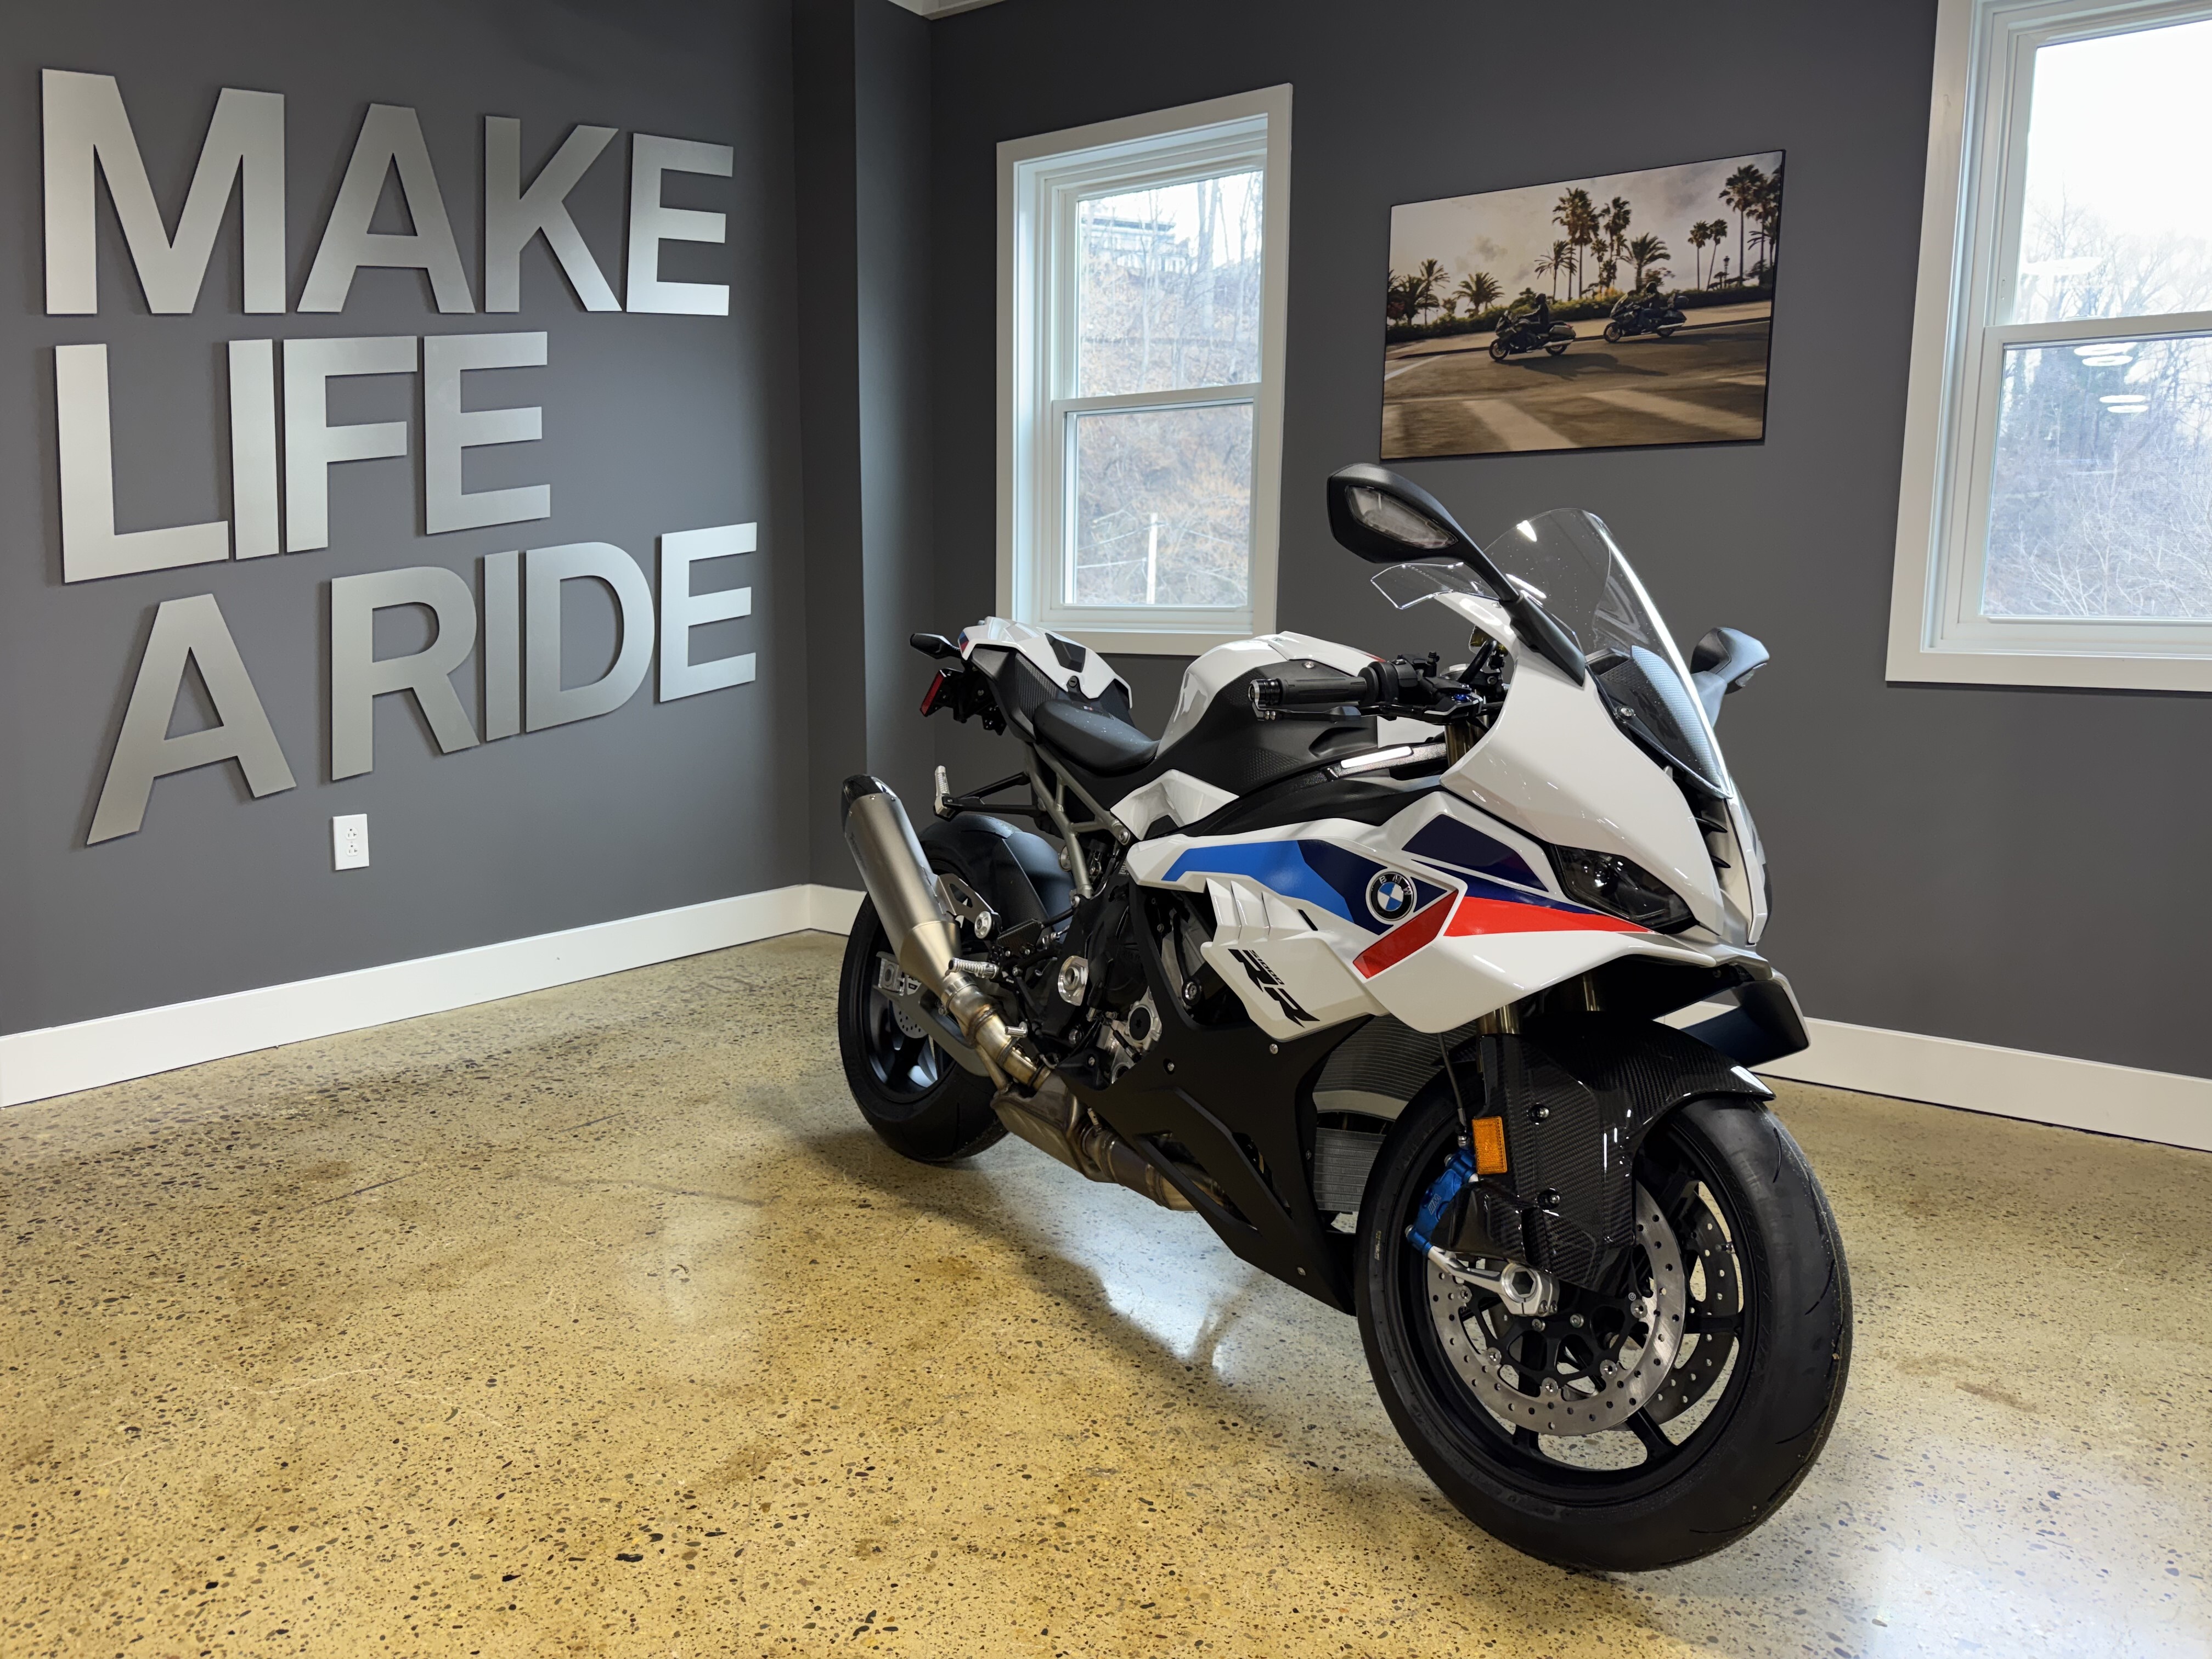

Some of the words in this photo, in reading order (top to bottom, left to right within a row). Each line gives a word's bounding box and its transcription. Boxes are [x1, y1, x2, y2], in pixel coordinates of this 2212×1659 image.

[42, 69, 733, 316] MAKE
[55, 331, 551, 584] LIFE
[86, 593, 297, 846] A
[331, 522, 757, 781] RIDE
[1227, 948, 1321, 1029] RR
[1379, 874, 1413, 895] BMW
